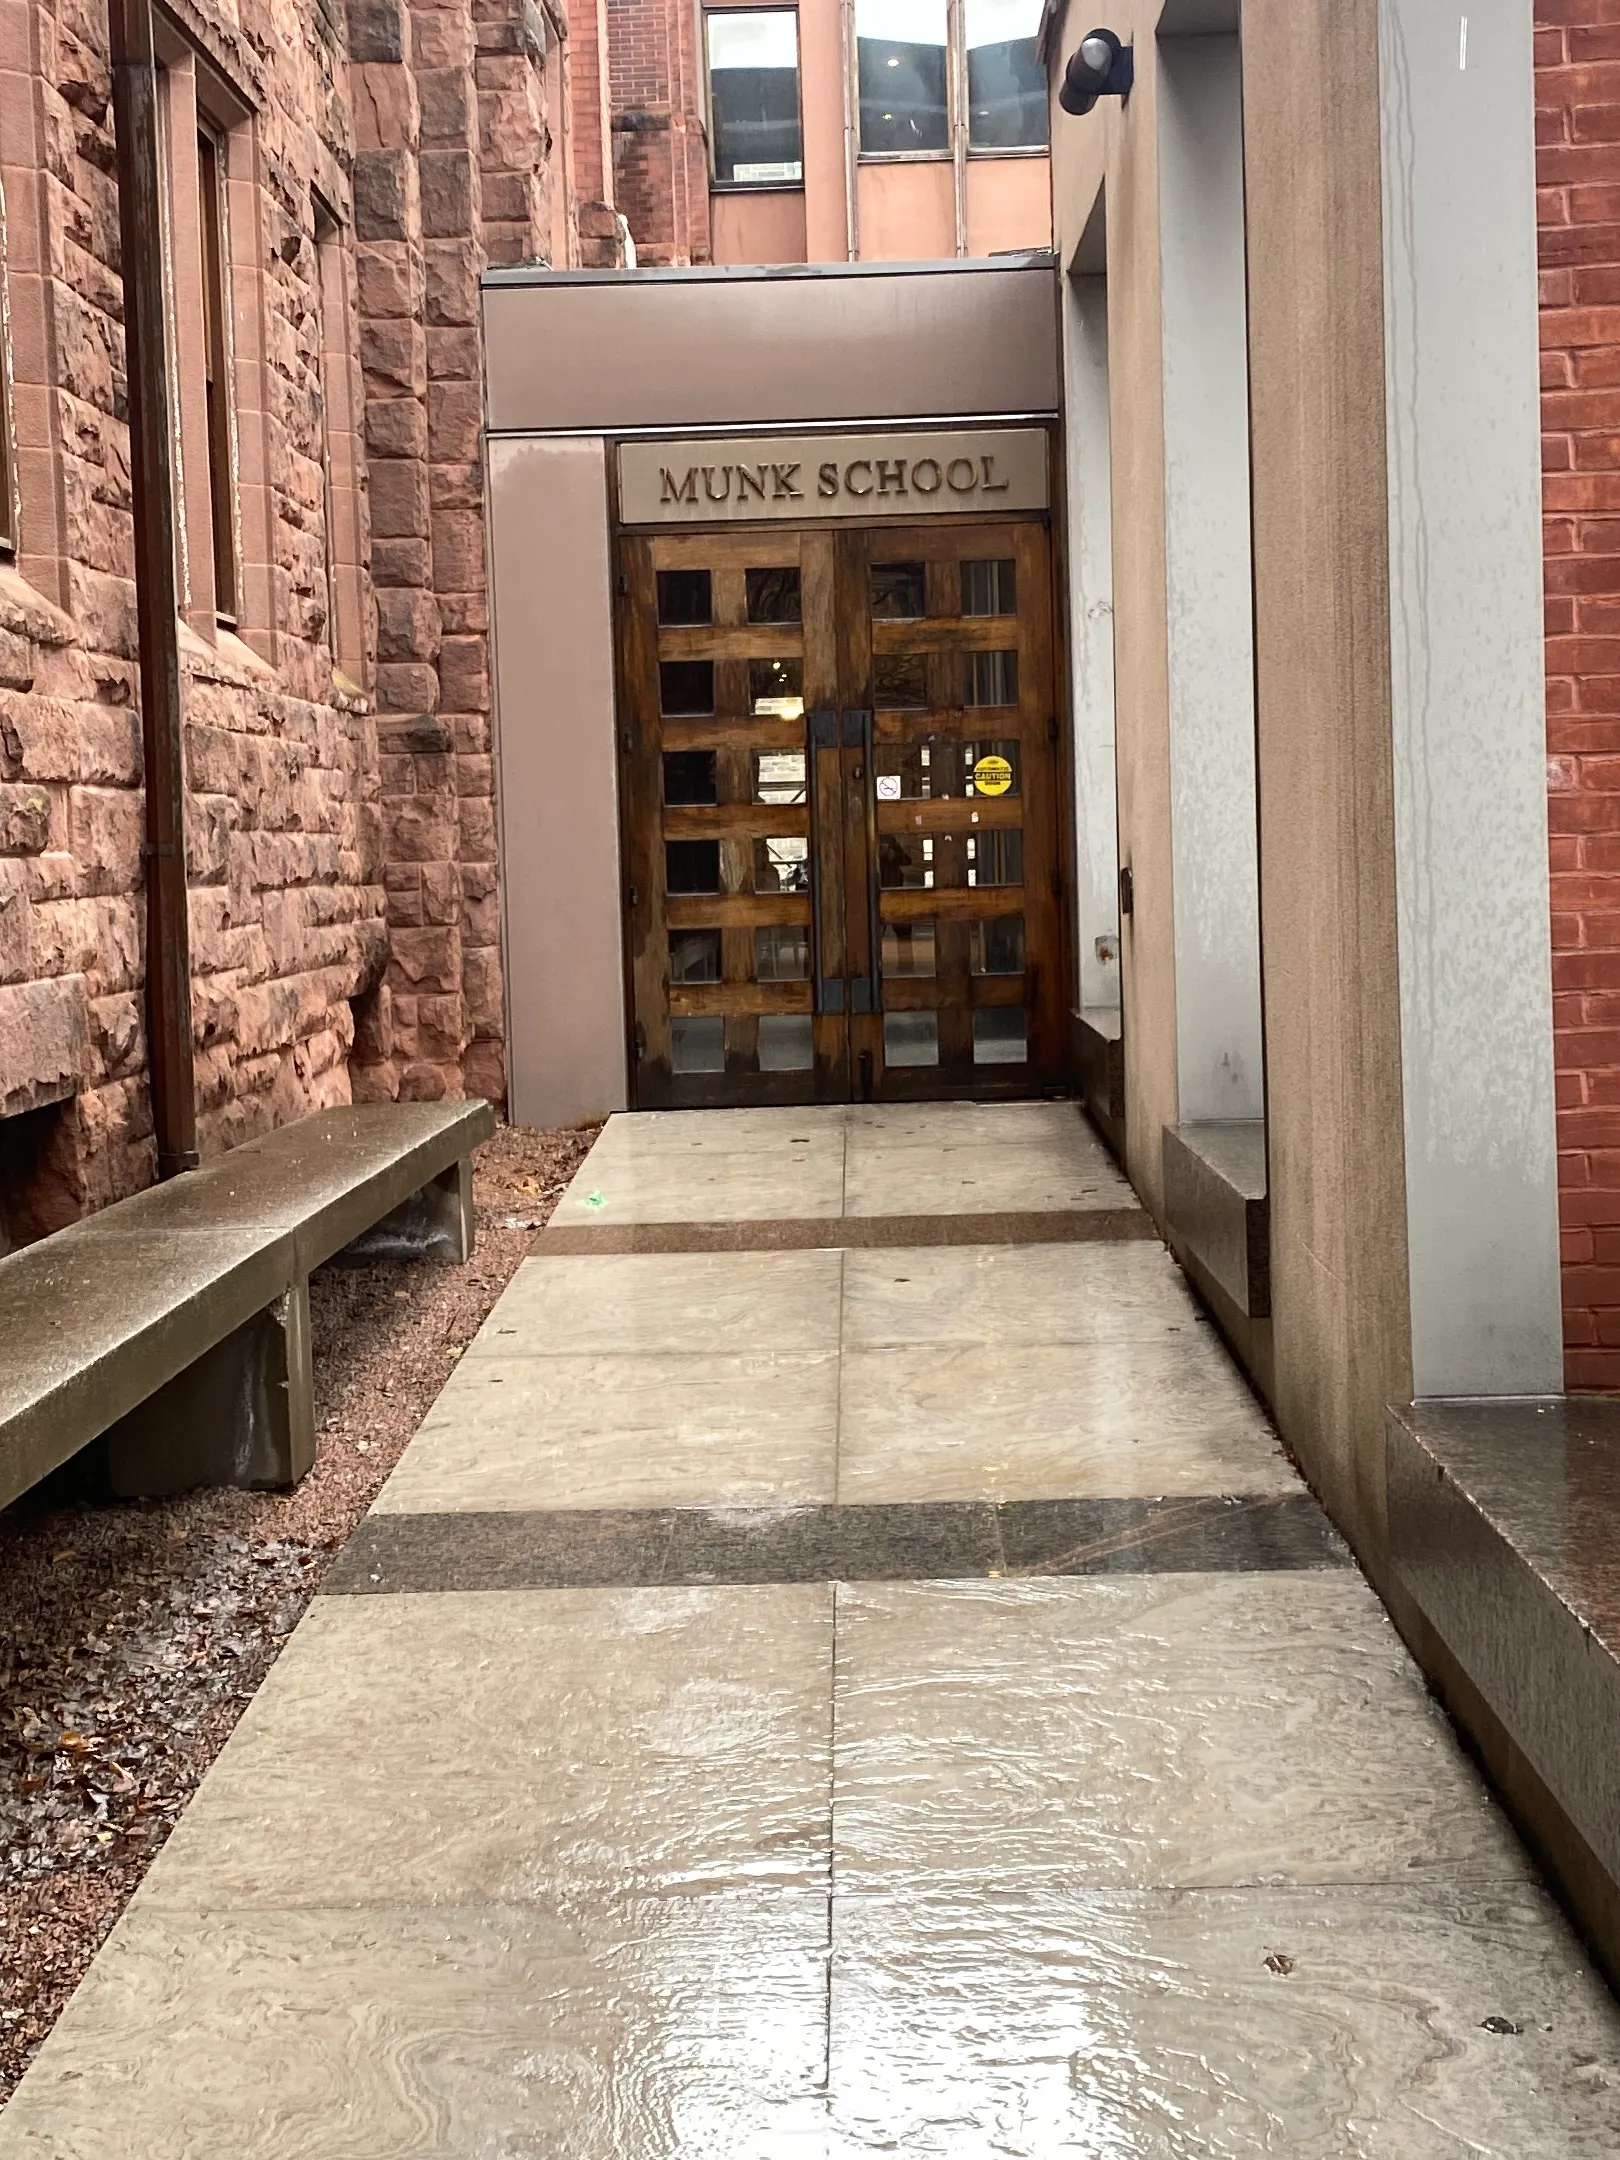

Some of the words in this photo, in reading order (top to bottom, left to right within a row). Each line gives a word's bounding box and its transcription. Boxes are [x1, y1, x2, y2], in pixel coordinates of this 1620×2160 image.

[660, 462, 804, 502] MUNK
[818, 456, 1008, 496] SCHOOL
[975, 772, 1011, 780] CAUTION
